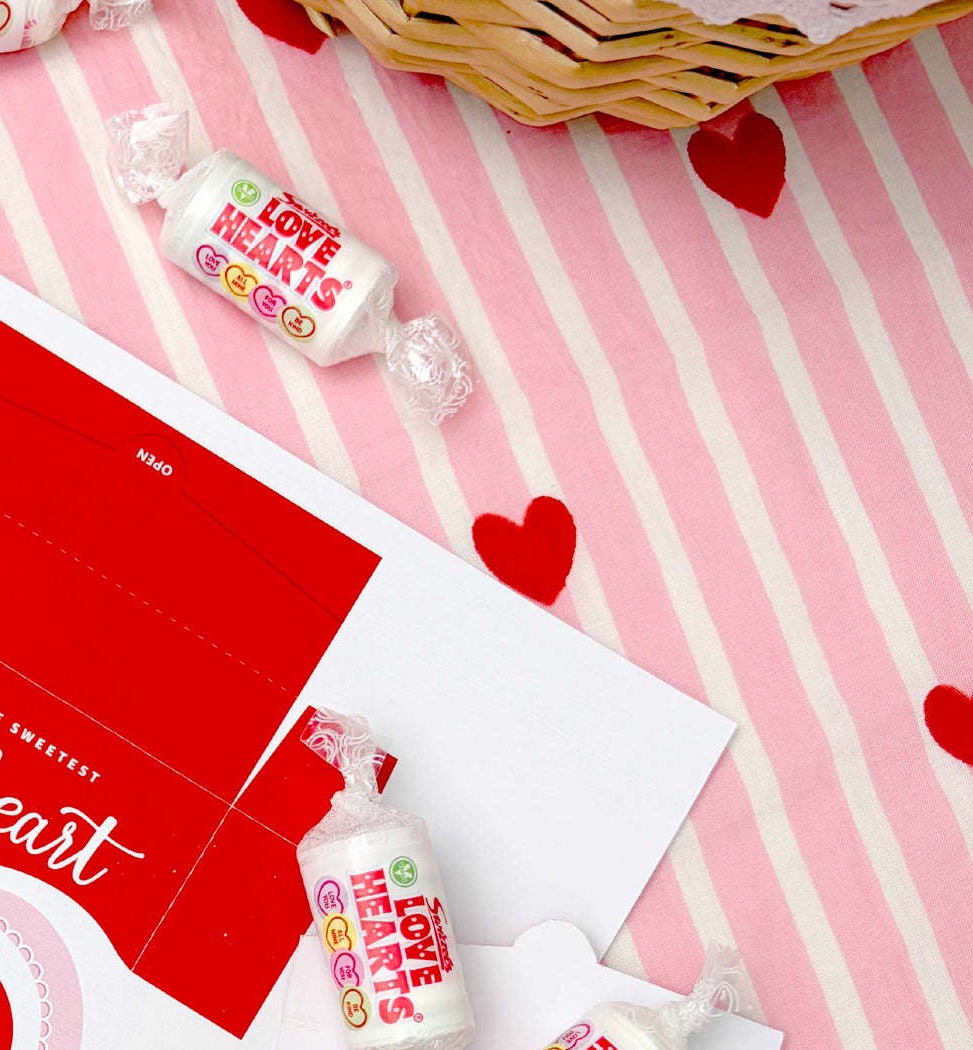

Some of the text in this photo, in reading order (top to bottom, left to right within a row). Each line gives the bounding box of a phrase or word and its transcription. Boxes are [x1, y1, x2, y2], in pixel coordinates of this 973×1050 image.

[256, 197, 342, 267] LOVE
[205, 254, 220, 266] LOVE
[205, 261, 216, 272] YOU
[232, 280, 245, 291] MINE
[236, 275, 247, 285] ALL
[265, 295, 276, 306] FOR
[262, 301, 273, 312] YOU
[288, 321, 303, 333] KIND
[294, 317, 303, 326] BE
[136, 447, 173, 476] OPEN
[9, 722, 102, 784] SWEETEST
[328, 891, 336, 908] LOVE
[394, 894, 443, 987] LOVE
[352, 1004, 359, 1013] BE
